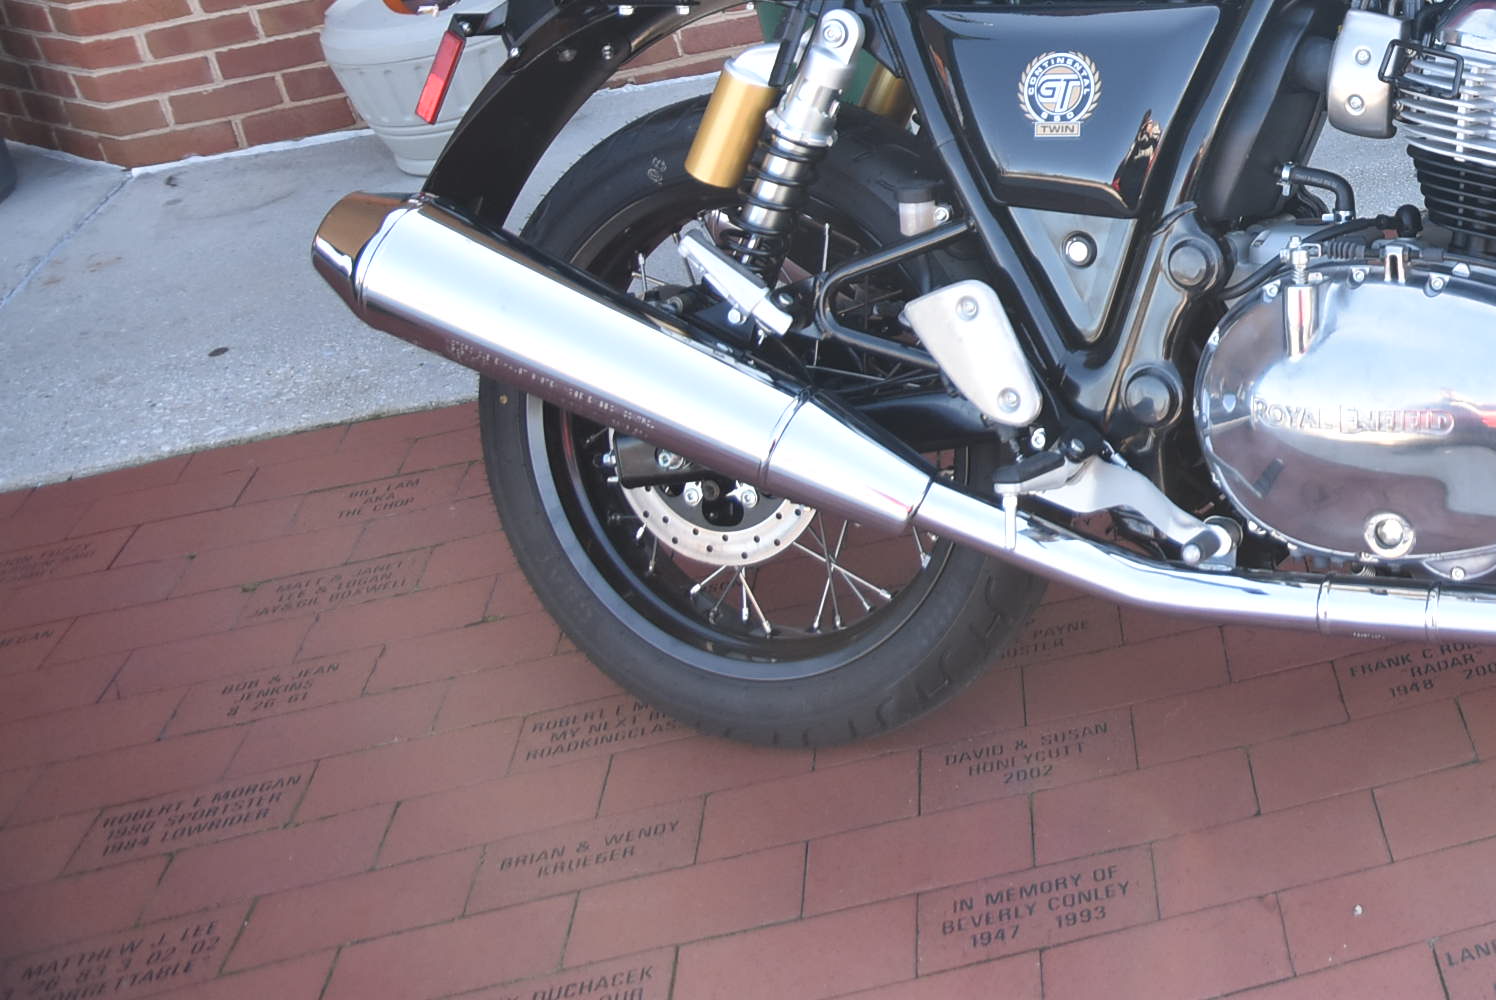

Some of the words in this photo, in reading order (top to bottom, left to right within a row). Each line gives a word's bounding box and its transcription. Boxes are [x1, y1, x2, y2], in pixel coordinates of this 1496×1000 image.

[1028, 56, 1091, 96] CONTINENTAL
[1038, 73, 1082, 113] GT
[1039, 125, 1075, 133] TWIN
[1252, 396, 1335, 429] ROYAL
[1338, 404, 1455, 436] ENFIELD
[1349, 653, 1412, 677] FRANK
[1389, 679, 1434, 698] 1948
[551, 727, 581, 743] MY
[944, 744, 1004, 766] DAVID
[1015, 739, 1028, 750] &
[1040, 722, 1108, 746] SUSAN
[968, 742, 1086, 777] HONEYCUTT
[1003, 765, 1054, 785] 2002
[103, 801, 184, 828] ROBERT
[211, 775, 301, 804] MORGAN
[160, 808, 270, 843] LOWRIDER
[500, 846, 566, 871] BRIAN
[576, 841, 590, 853] &
[604, 820, 680, 847] WENDY
[537, 846, 636, 878] KRUEGER
[941, 903, 1037, 936] BEVERLY
[1048, 881, 1130, 912] CONLEY
[952, 896, 974, 913] IN
[985, 872, 1083, 907] MEMORY
[1092, 865, 1118, 883] OF
[970, 924, 1020, 948] 1947
[1055, 905, 1107, 928] 1993
